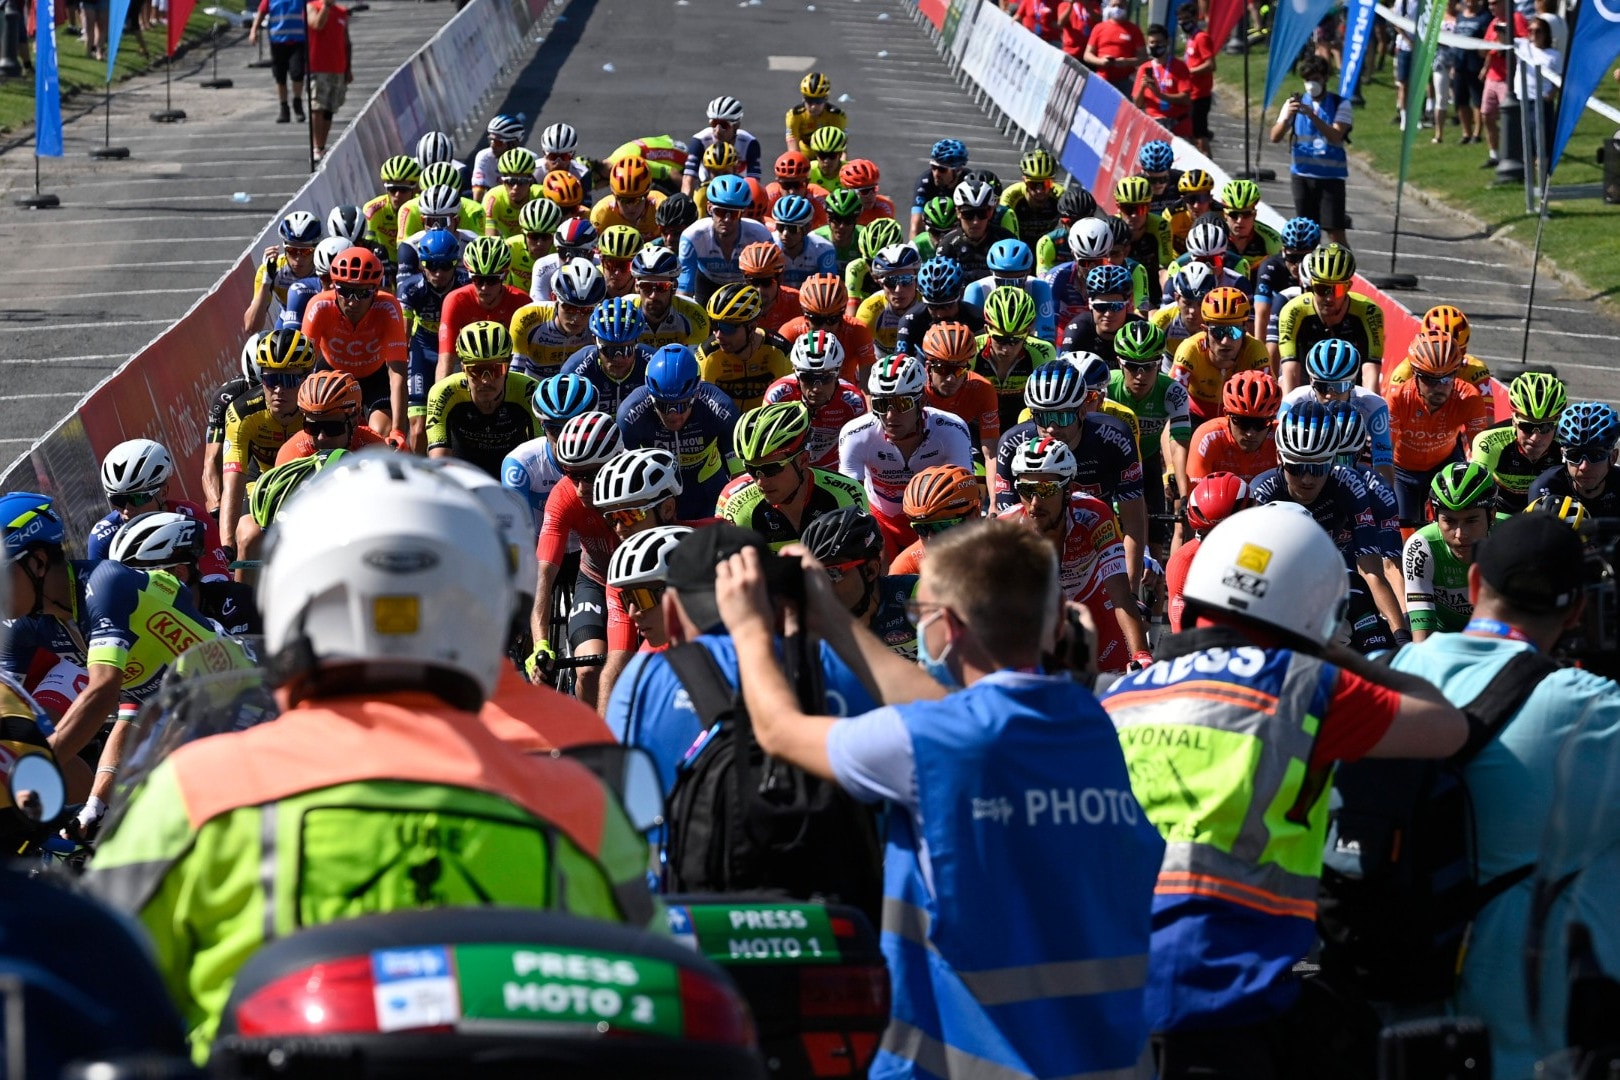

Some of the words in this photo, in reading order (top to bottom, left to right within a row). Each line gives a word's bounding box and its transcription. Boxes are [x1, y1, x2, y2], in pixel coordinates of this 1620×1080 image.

[328, 337, 383, 357] CCC
[1176, 356, 1194, 369] Uno
[1251, 357, 1269, 367] Uno
[427, 398, 437, 416] BIKE
[433, 385, 455, 417] EXCHANGE
[998, 430, 1031, 466] FENIX
[1094, 423, 1133, 457] Alpecin
[1331, 465, 1368, 500] Alpecin
[1362, 470, 1396, 507] Alpecin
[1404, 538, 1424, 582] SEGUROS
[1413, 550, 1429, 579] RGA
[1024, 787, 1139, 827] PHOTO
[728, 909, 808, 931] PRESS
[728, 937, 801, 959] MOTO
[808, 938, 823, 957] 1
[511, 950, 640, 986] PRESS
[502, 981, 623, 1017] MOTO
[630, 995, 655, 1024] 2
